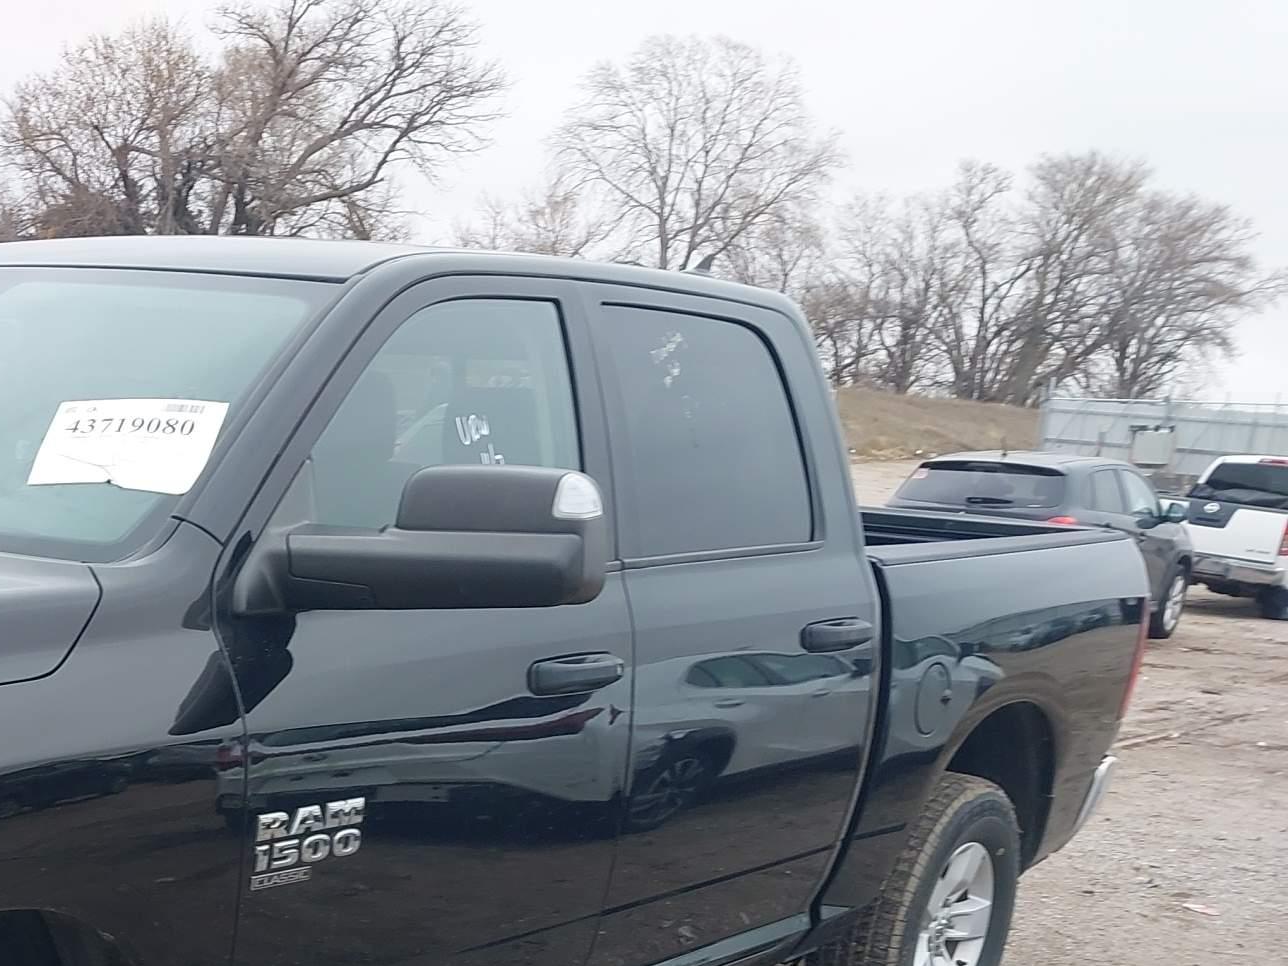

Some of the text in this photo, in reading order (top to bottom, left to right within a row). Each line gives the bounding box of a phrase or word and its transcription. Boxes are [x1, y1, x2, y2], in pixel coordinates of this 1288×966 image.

[65, 417, 195, 436] 43719080
[255, 797, 366, 842] RAM
[253, 828, 362, 873] 1500
[253, 867, 312, 889] CLASSIC
